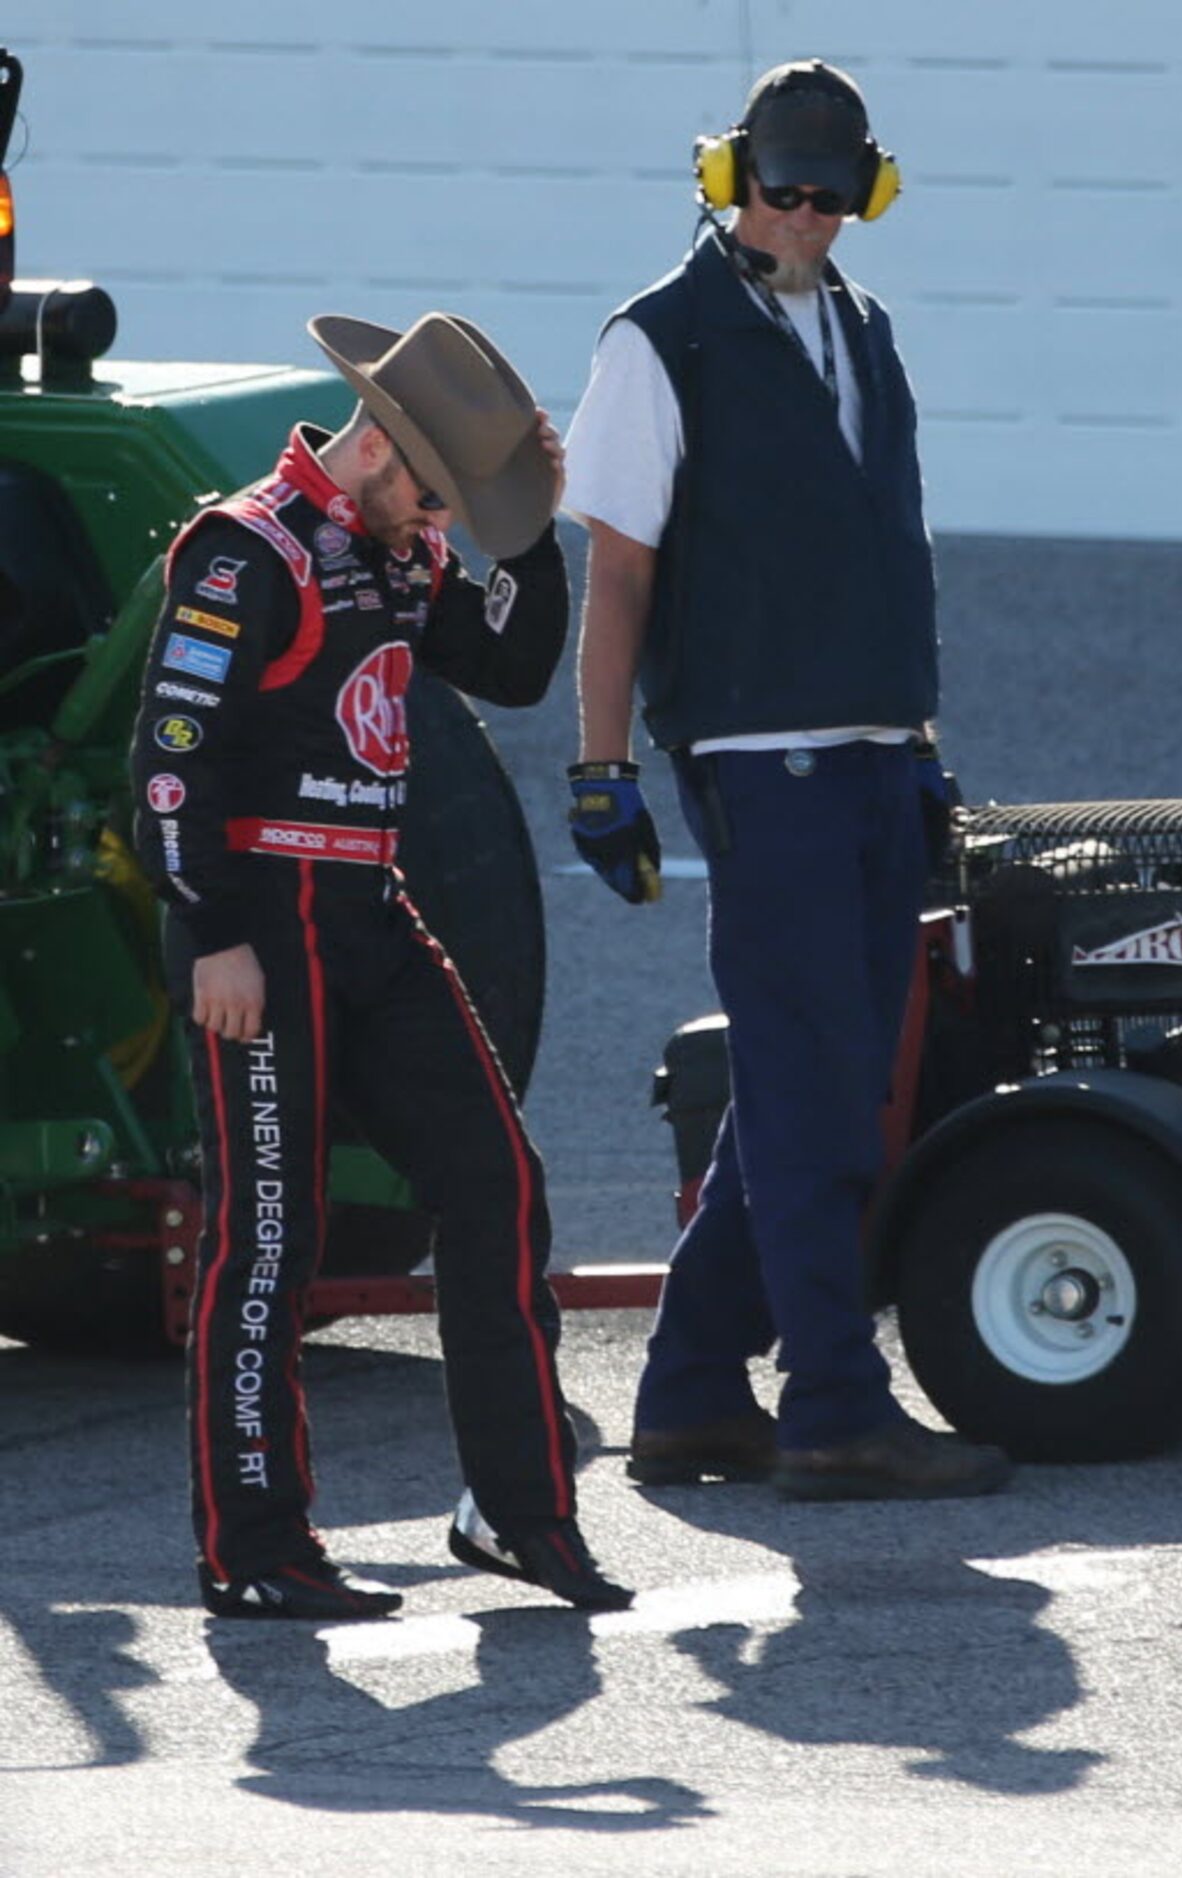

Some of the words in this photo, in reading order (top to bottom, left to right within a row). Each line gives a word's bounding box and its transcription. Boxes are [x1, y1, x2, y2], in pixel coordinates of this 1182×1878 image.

[249, 1032, 277, 1094] THE
[251, 1102, 283, 1171] NEW
[249, 1180, 284, 1295] DEGREE
[240, 1299, 270, 1341] OF
